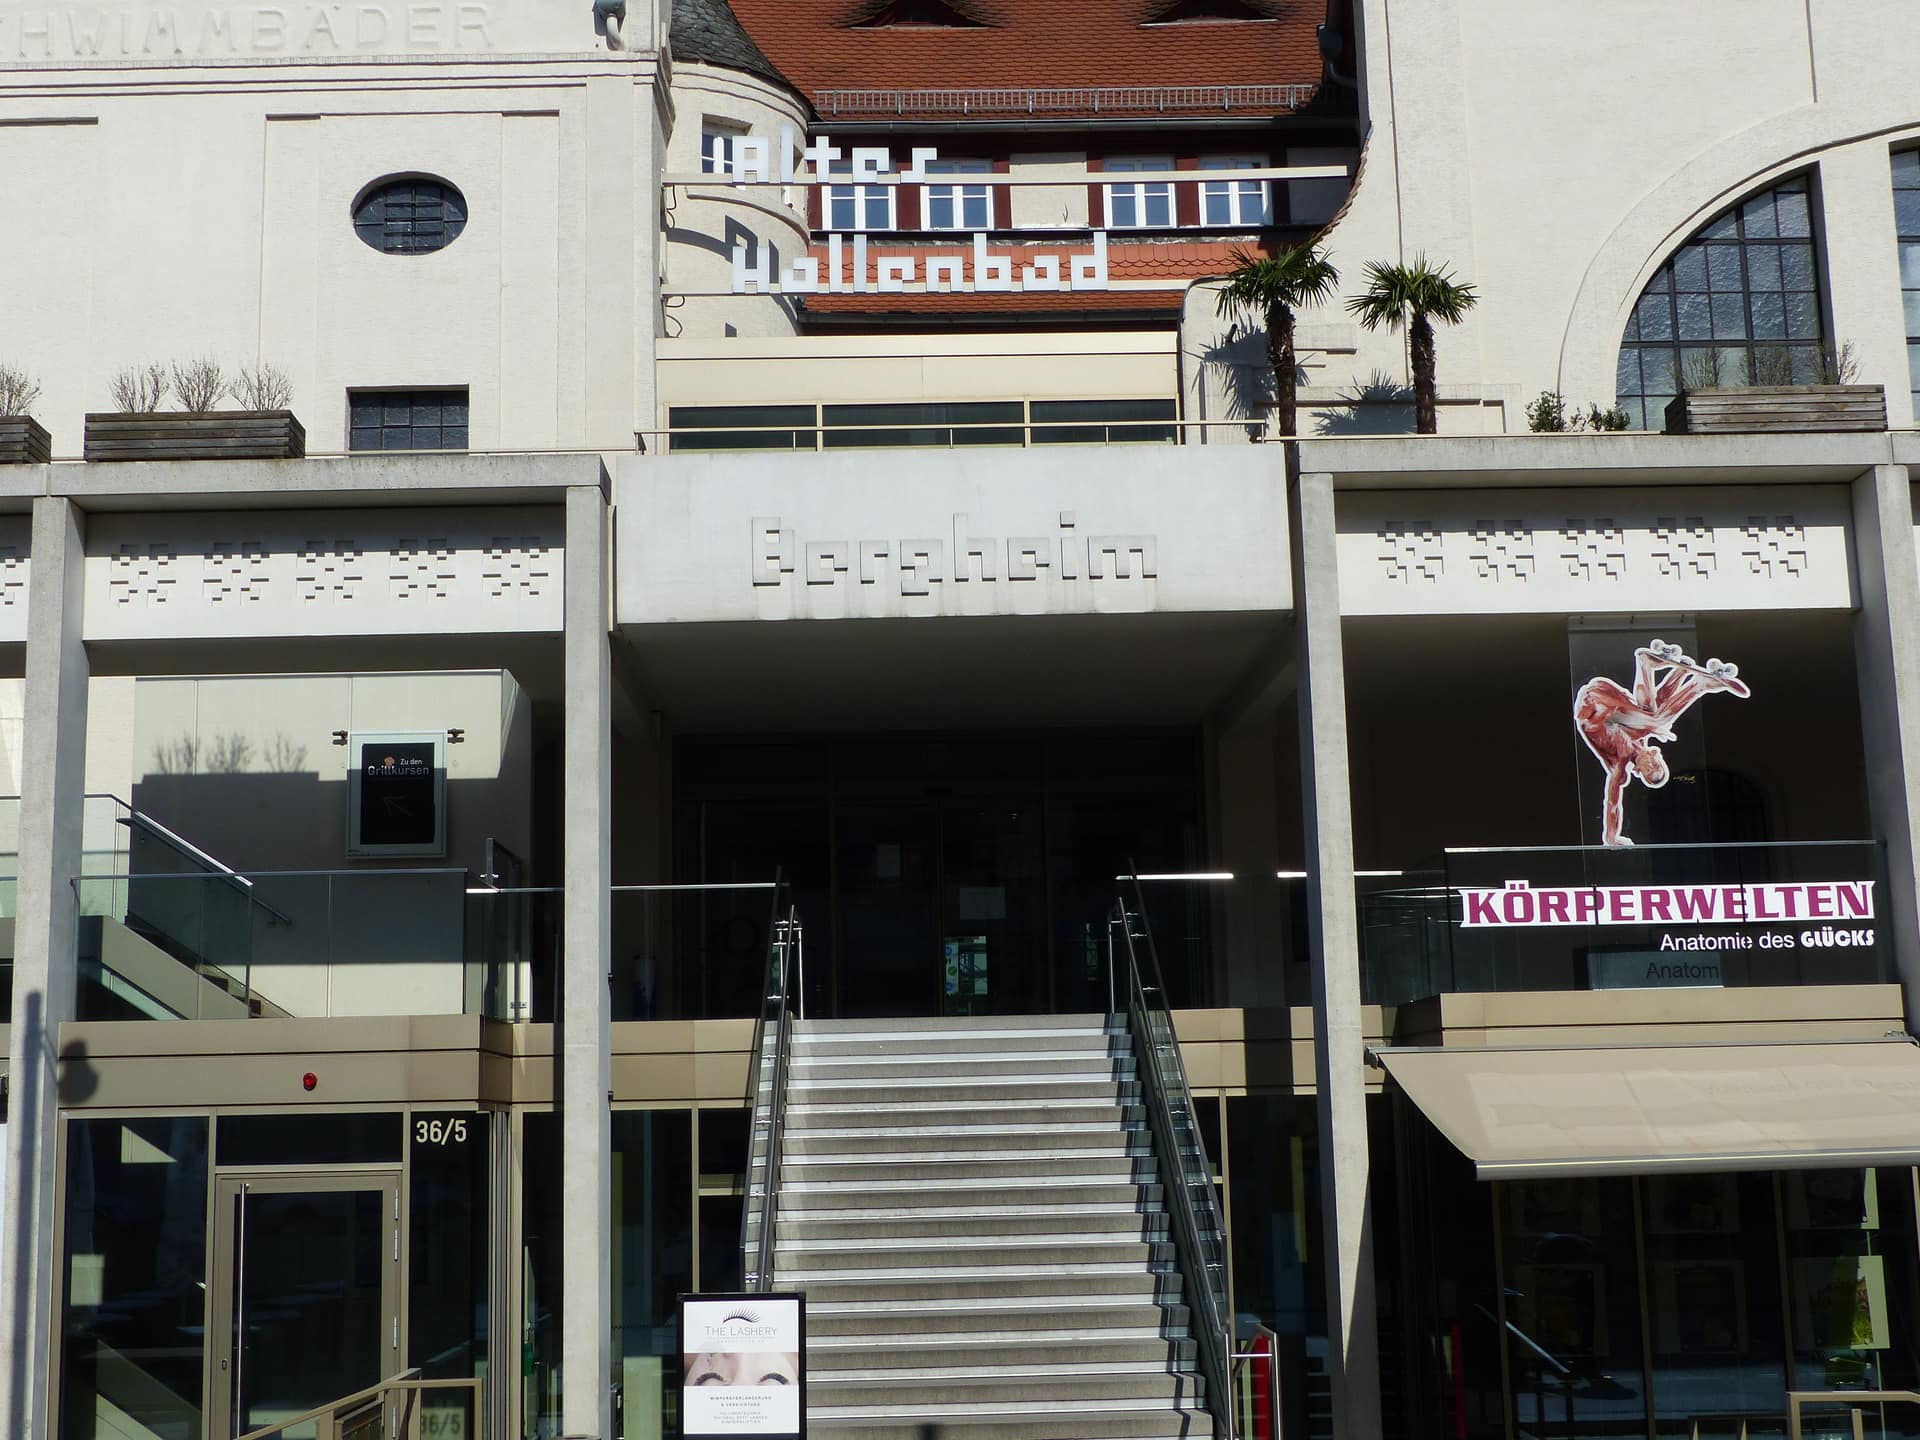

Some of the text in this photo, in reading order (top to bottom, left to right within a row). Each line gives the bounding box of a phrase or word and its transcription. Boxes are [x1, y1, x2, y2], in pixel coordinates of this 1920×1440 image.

[0, 2, 496, 58] HWIMMBÄDER
[732, 124, 938, 184] Altes
[732, 231, 1109, 294] Hallenbad
[751, 511, 1158, 597] Bergheim
[368, 765, 429, 775] Grillkursen
[1465, 881, 1871, 925] KÖRPERWELTEN
[1660, 926, 1874, 951] Anatomie des GLÜCKS
[416, 1118, 467, 1145] 36/5
[704, 1325, 777, 1337] THE LASHERY
